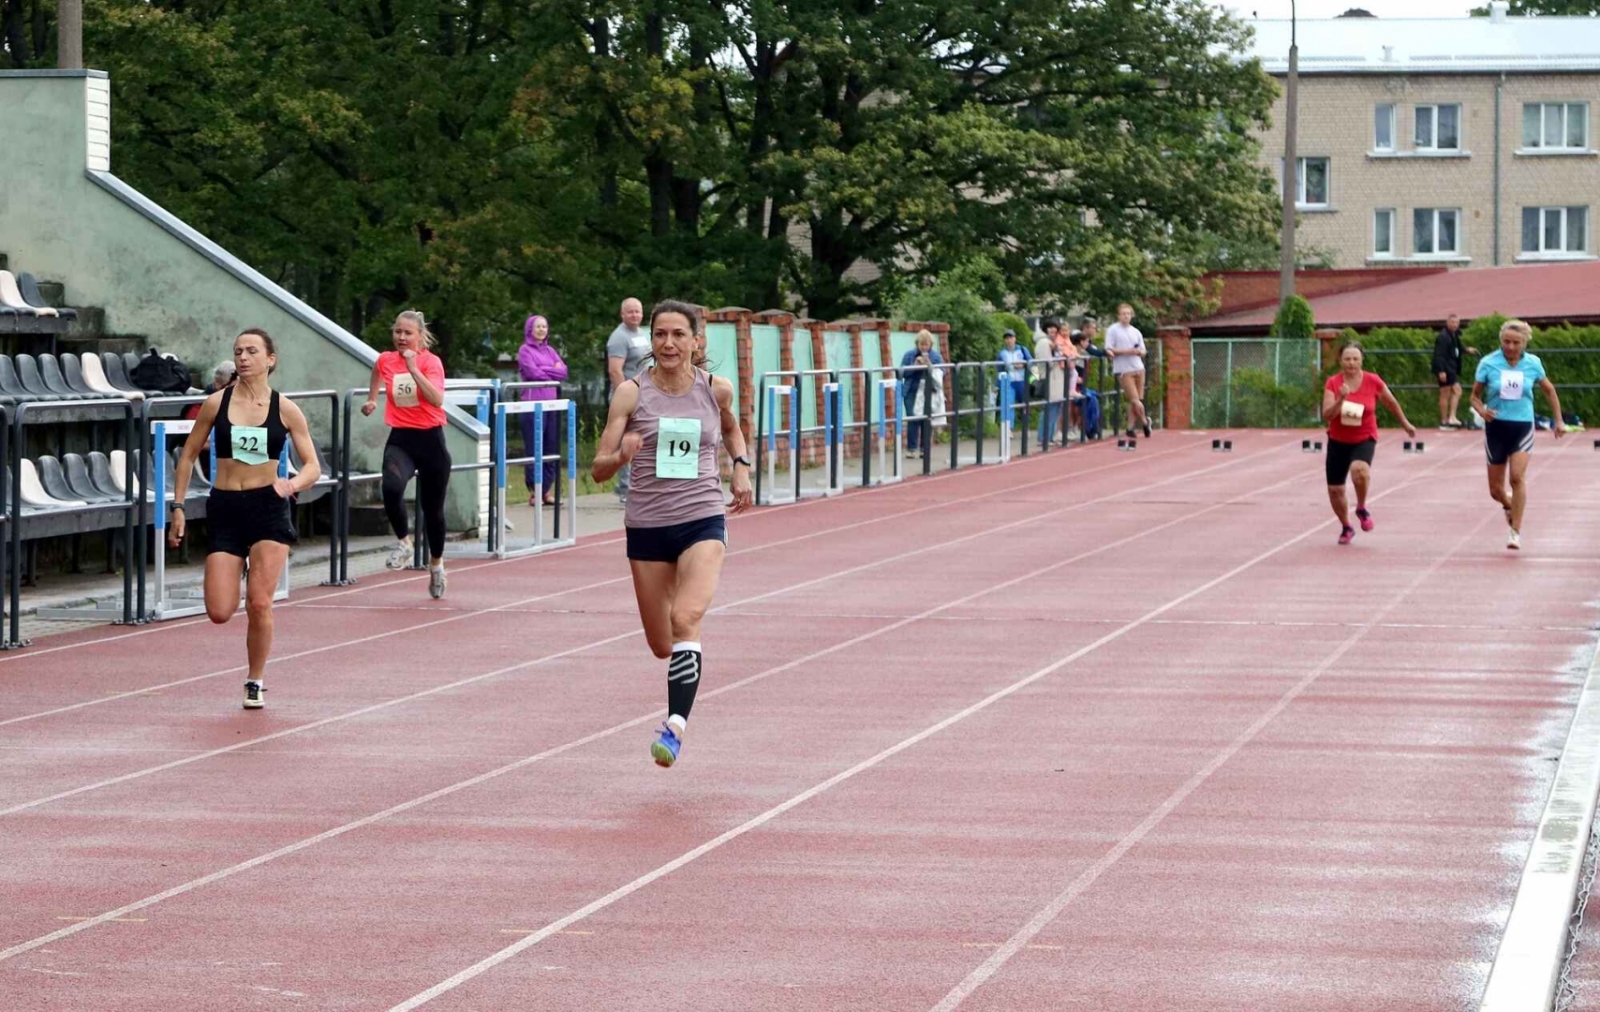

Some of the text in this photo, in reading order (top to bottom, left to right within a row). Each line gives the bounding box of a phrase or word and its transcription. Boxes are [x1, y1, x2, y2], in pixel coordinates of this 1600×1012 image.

[398, 383, 412, 395] 56
[239, 436, 259, 451] 22
[668, 439, 691, 457] 19
